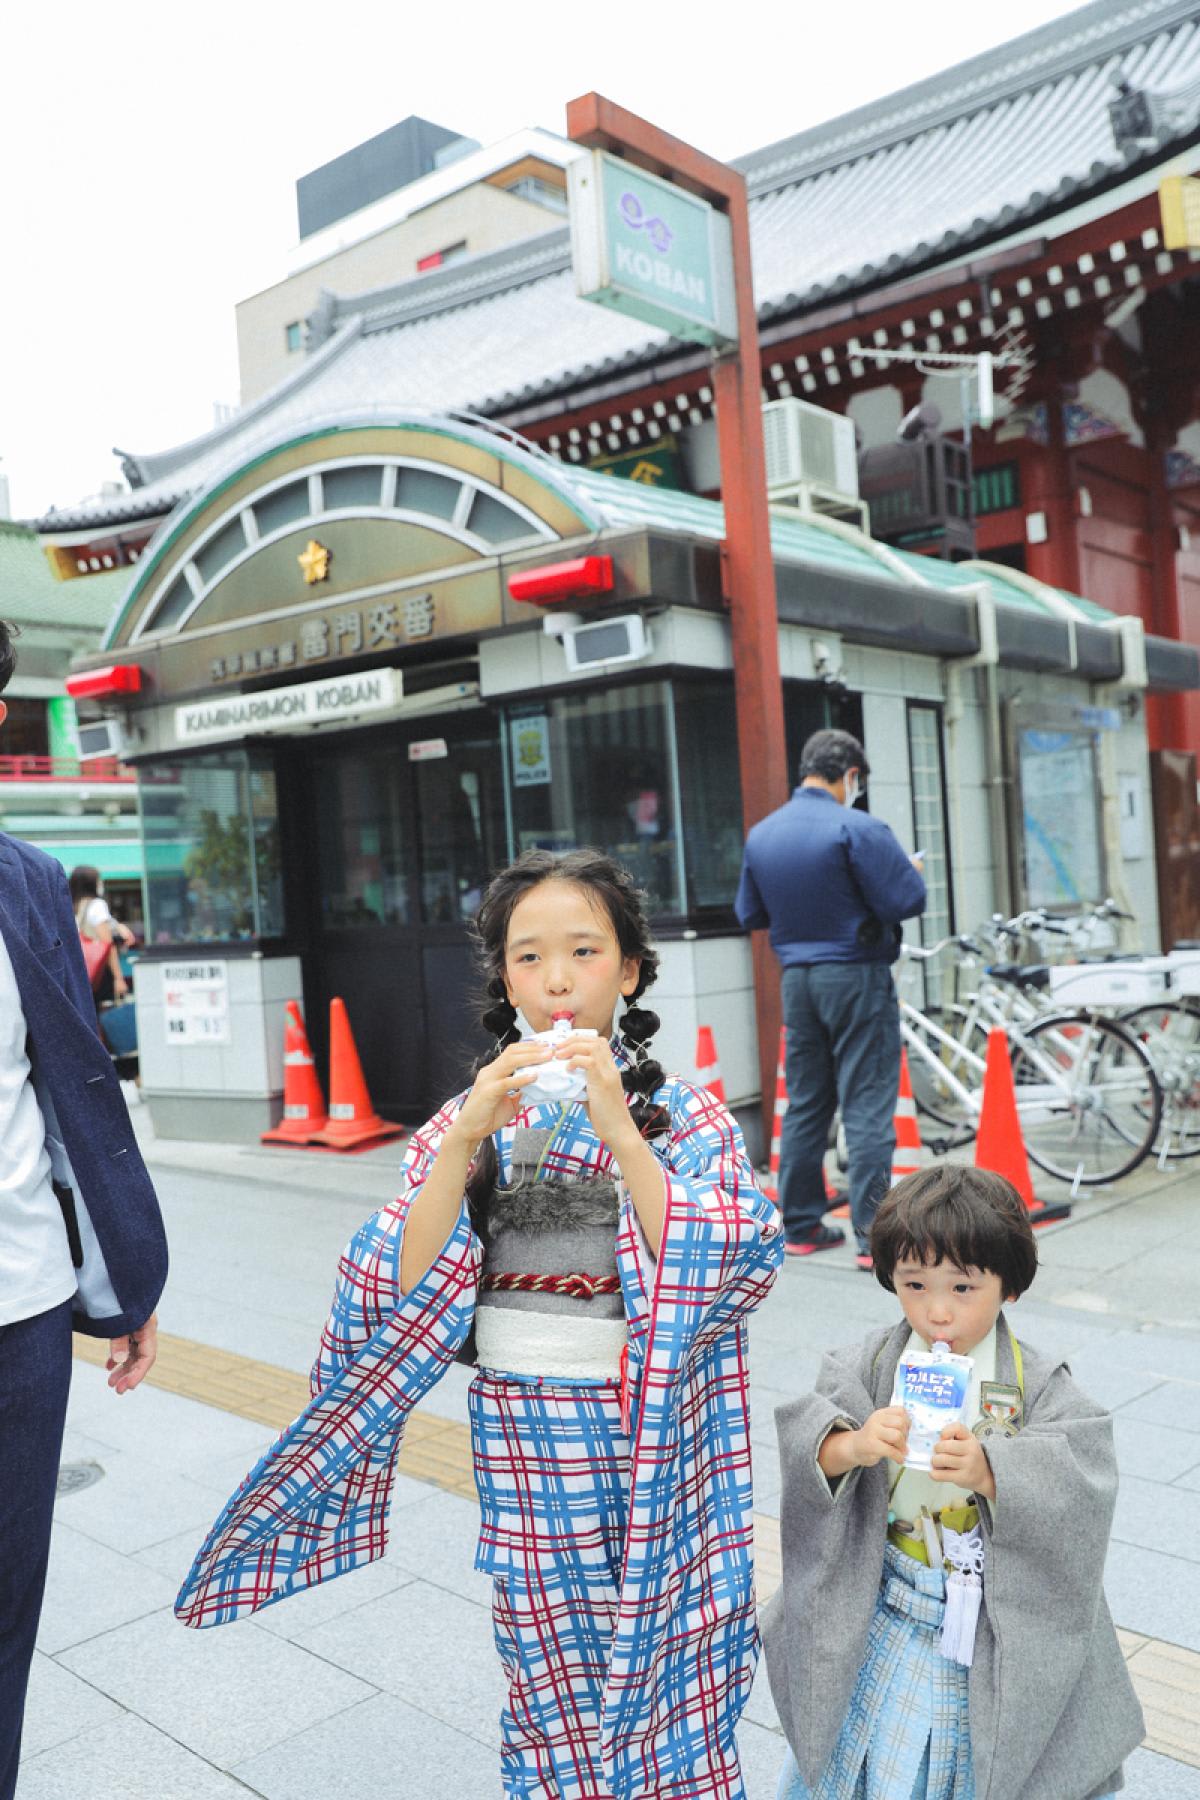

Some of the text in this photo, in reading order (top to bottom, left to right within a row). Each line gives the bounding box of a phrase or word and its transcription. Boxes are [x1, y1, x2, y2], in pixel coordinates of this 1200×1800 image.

[616, 241, 705, 305] KOBAN
[185, 679, 382, 732] KAMINARIMON KOBAN
[906, 1371, 955, 1386] カルピス
